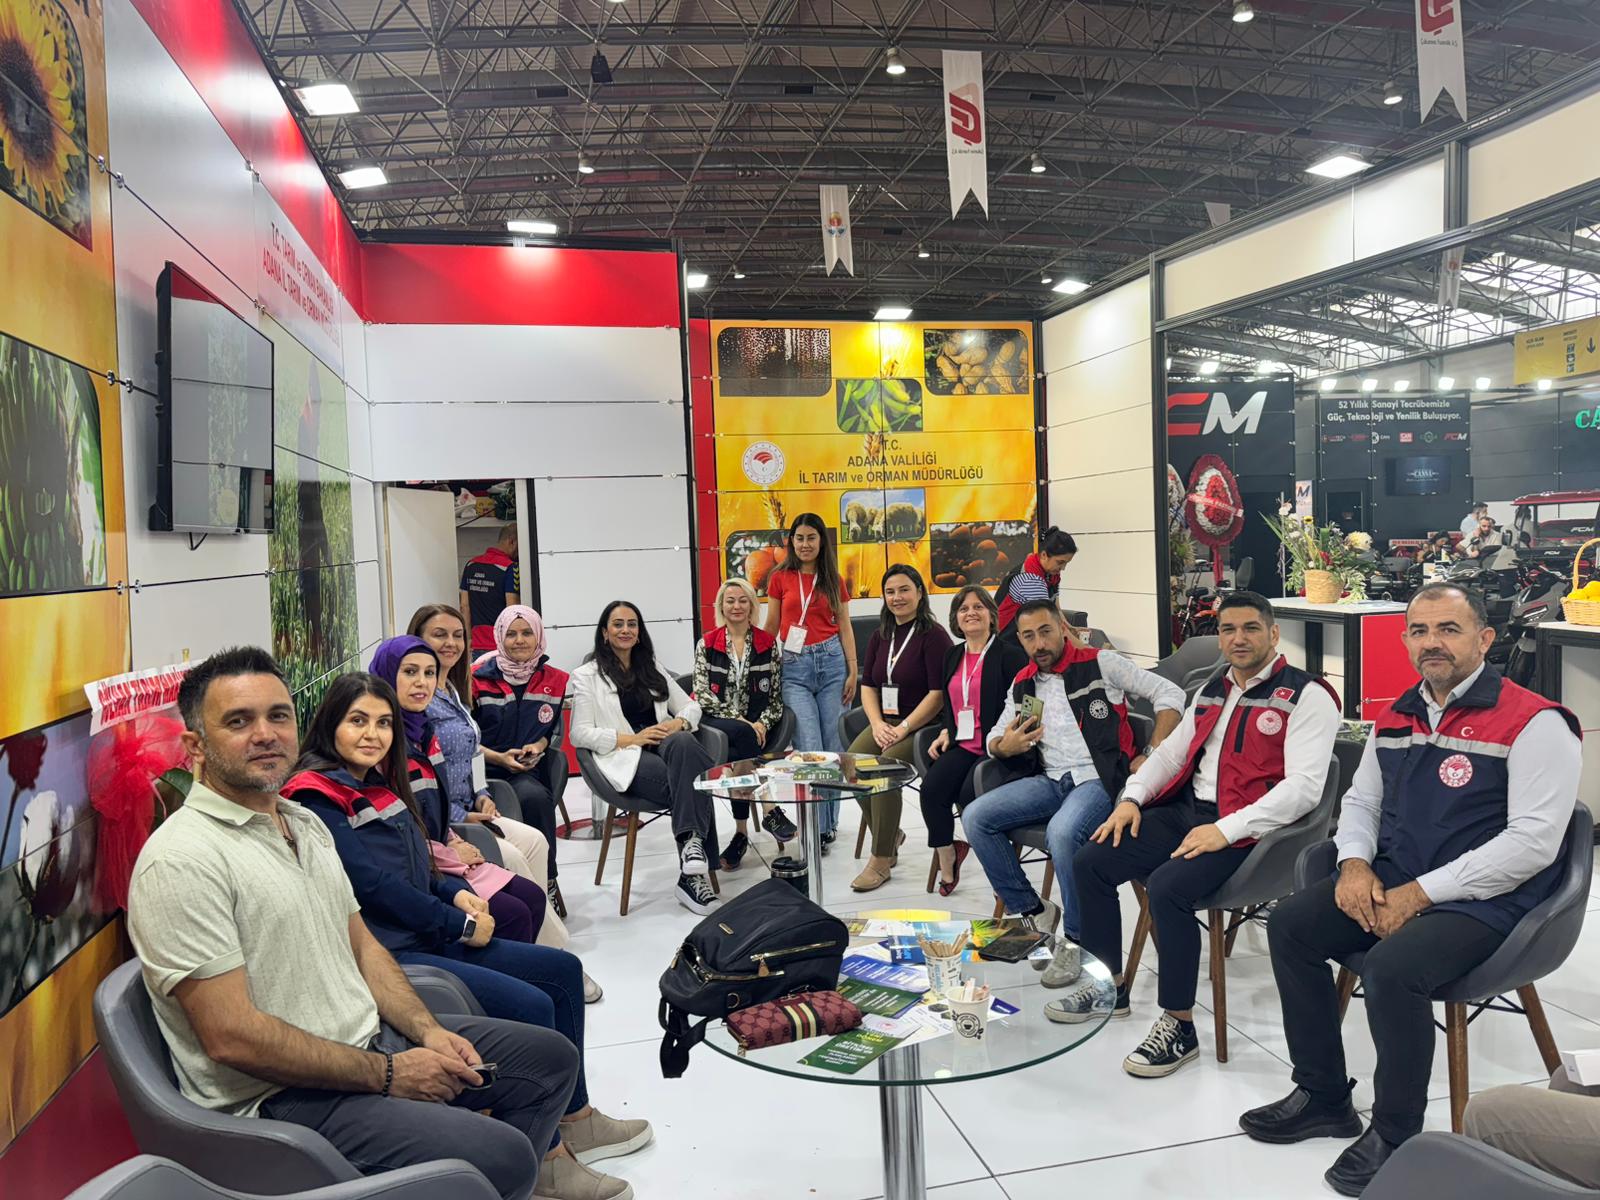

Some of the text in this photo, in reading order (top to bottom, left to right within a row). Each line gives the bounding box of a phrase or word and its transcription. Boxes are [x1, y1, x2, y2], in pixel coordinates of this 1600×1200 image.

[281, 233, 296, 270] TARIM
[263, 247, 281, 285] ADANA
[1338, 399, 1450, 410] 52 Yıllık Sanayi Tecrübemizle
[1327, 411, 1462, 423] Güç, Teknoloji ve Yenilik Buluşuyor.
[884, 439, 902, 451] T.C.
[848, 451, 937, 467] ADANA VALİLİĞİ
[799, 465, 983, 484] İL TARIM ve ORMAN MÜDÜRLÜĞÜ
